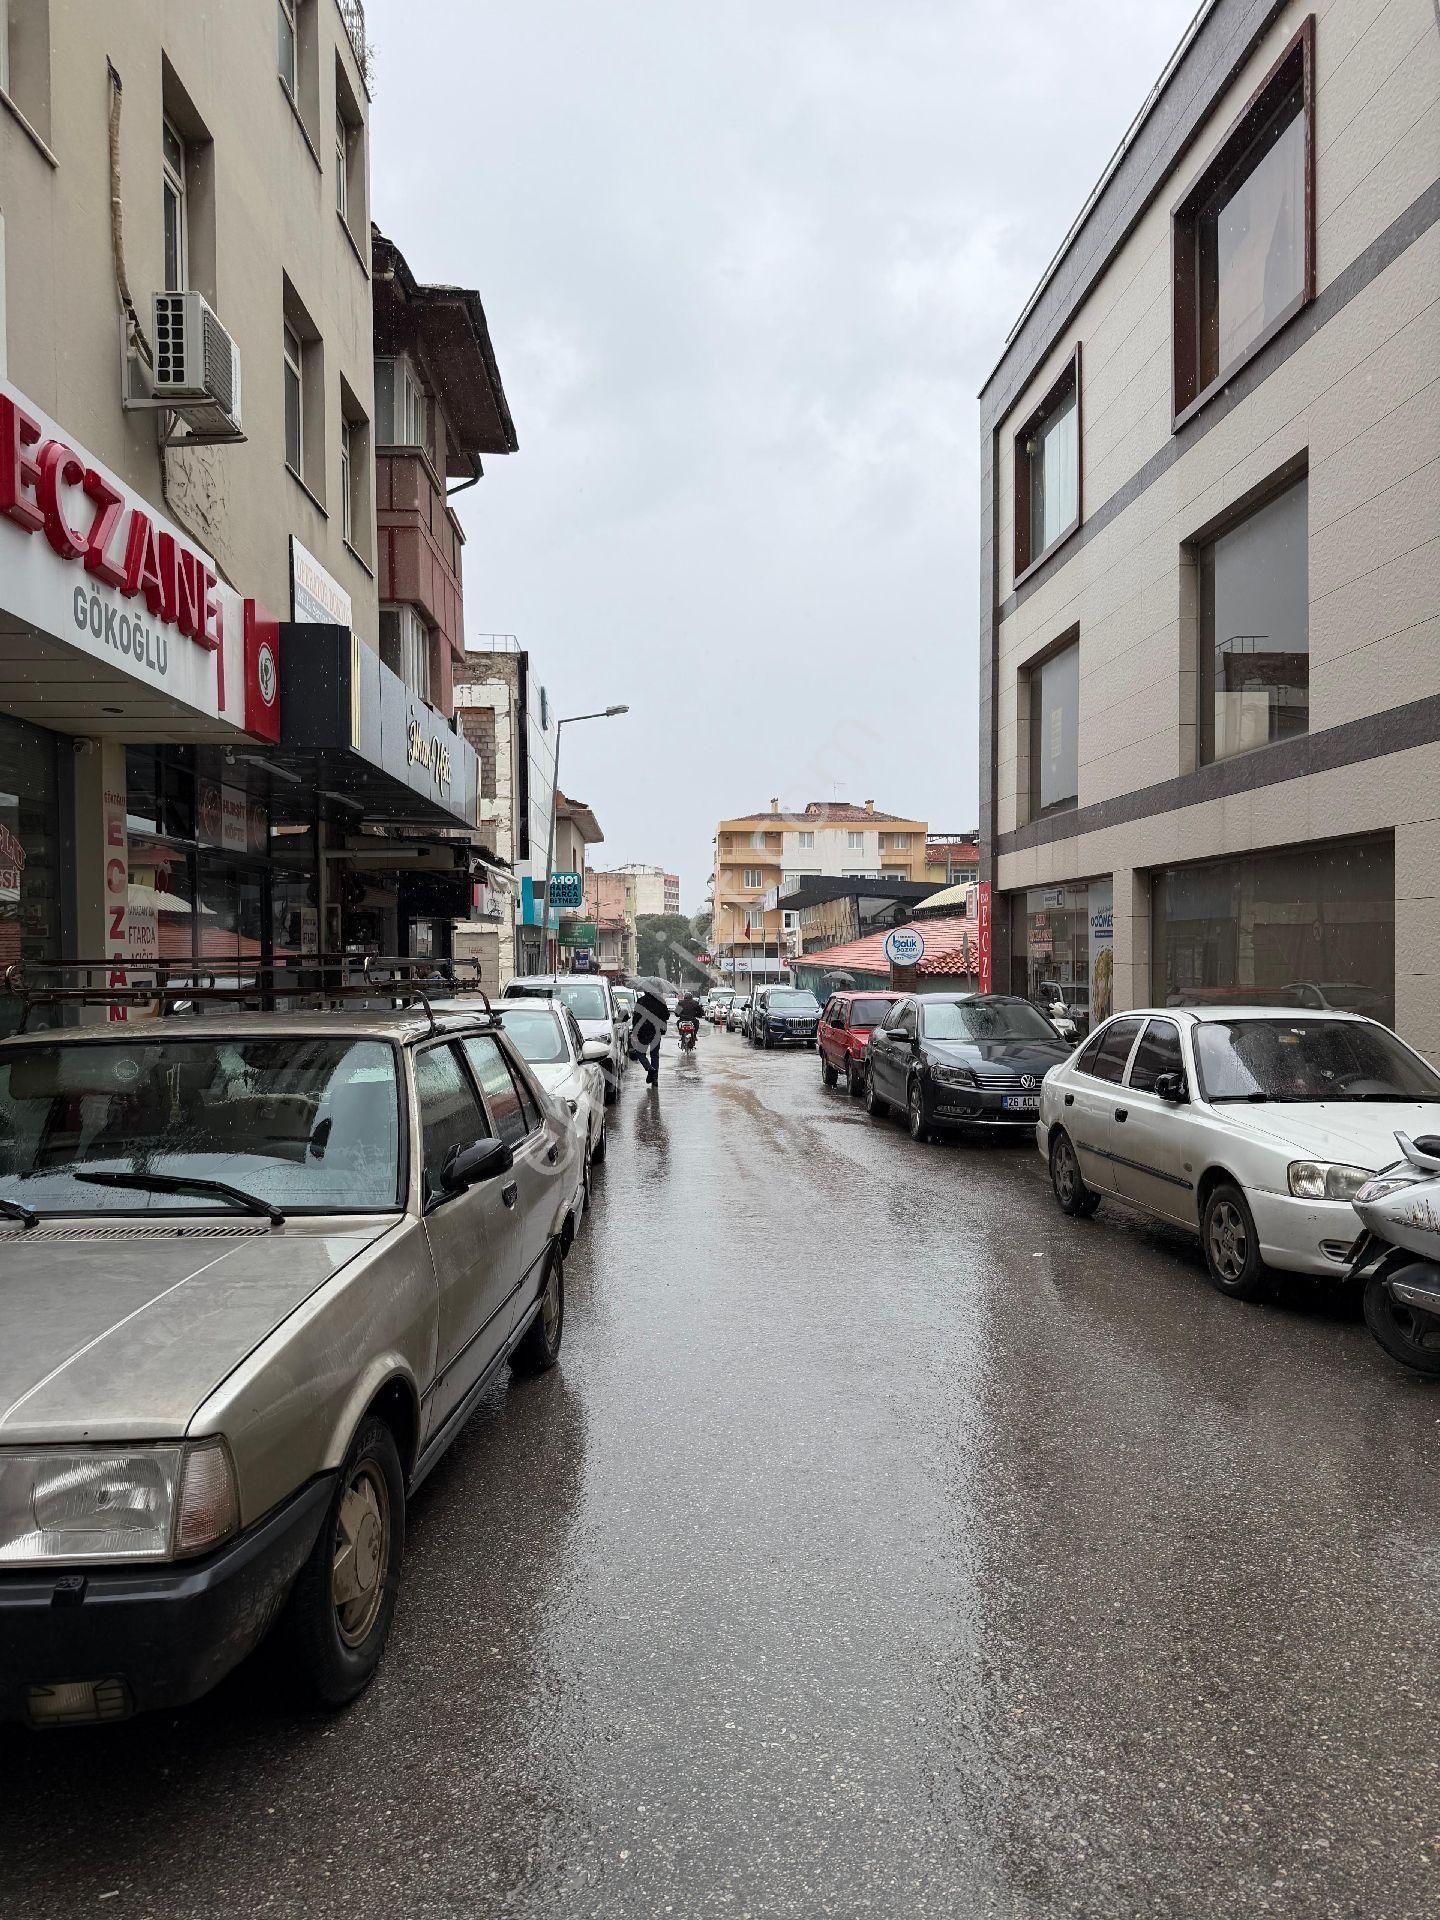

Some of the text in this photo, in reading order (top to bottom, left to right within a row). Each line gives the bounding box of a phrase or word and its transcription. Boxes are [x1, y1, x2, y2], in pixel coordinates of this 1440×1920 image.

[0, 392, 220, 652] ECZANE
[73, 583, 168, 676] GÖKOĞLU
[1008, 1097, 1038, 1107] 26 ACL
